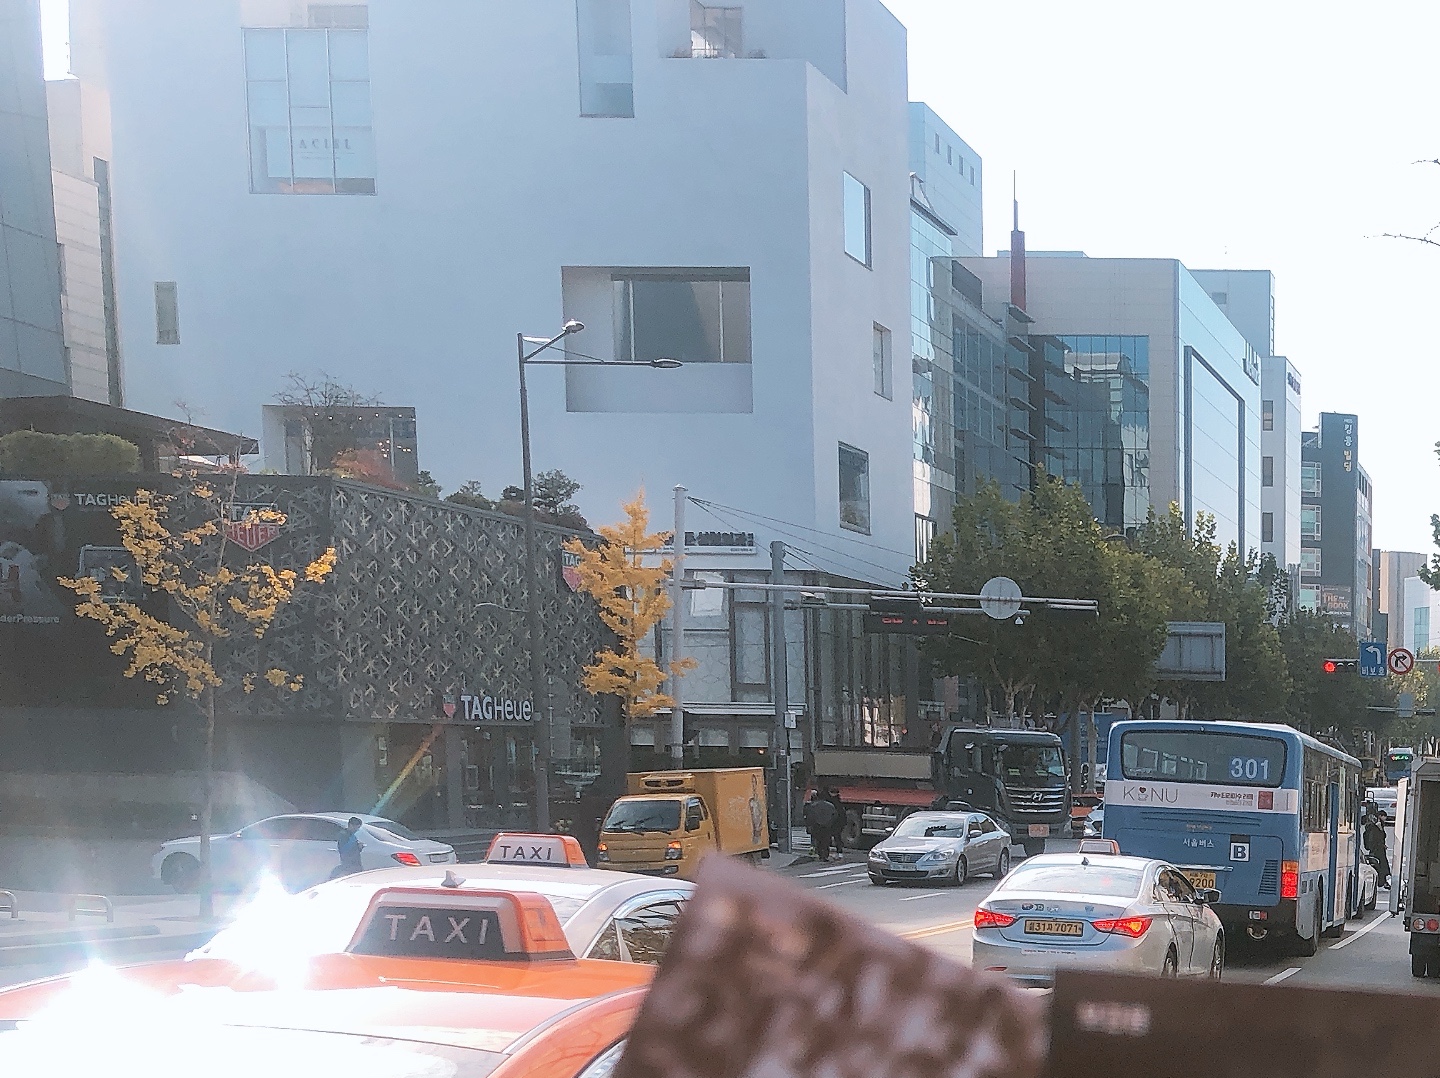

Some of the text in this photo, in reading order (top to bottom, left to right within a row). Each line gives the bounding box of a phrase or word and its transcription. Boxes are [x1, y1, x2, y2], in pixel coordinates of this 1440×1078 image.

[1361, 666, 1385, 676] 비보호
[1231, 758, 1269, 780] 301
[1182, 838, 1215, 848] 서울버스
[499, 845, 552, 860] TAXI
[1233, 845, 1247, 859] B
[384, 914, 488, 945] TAXI
